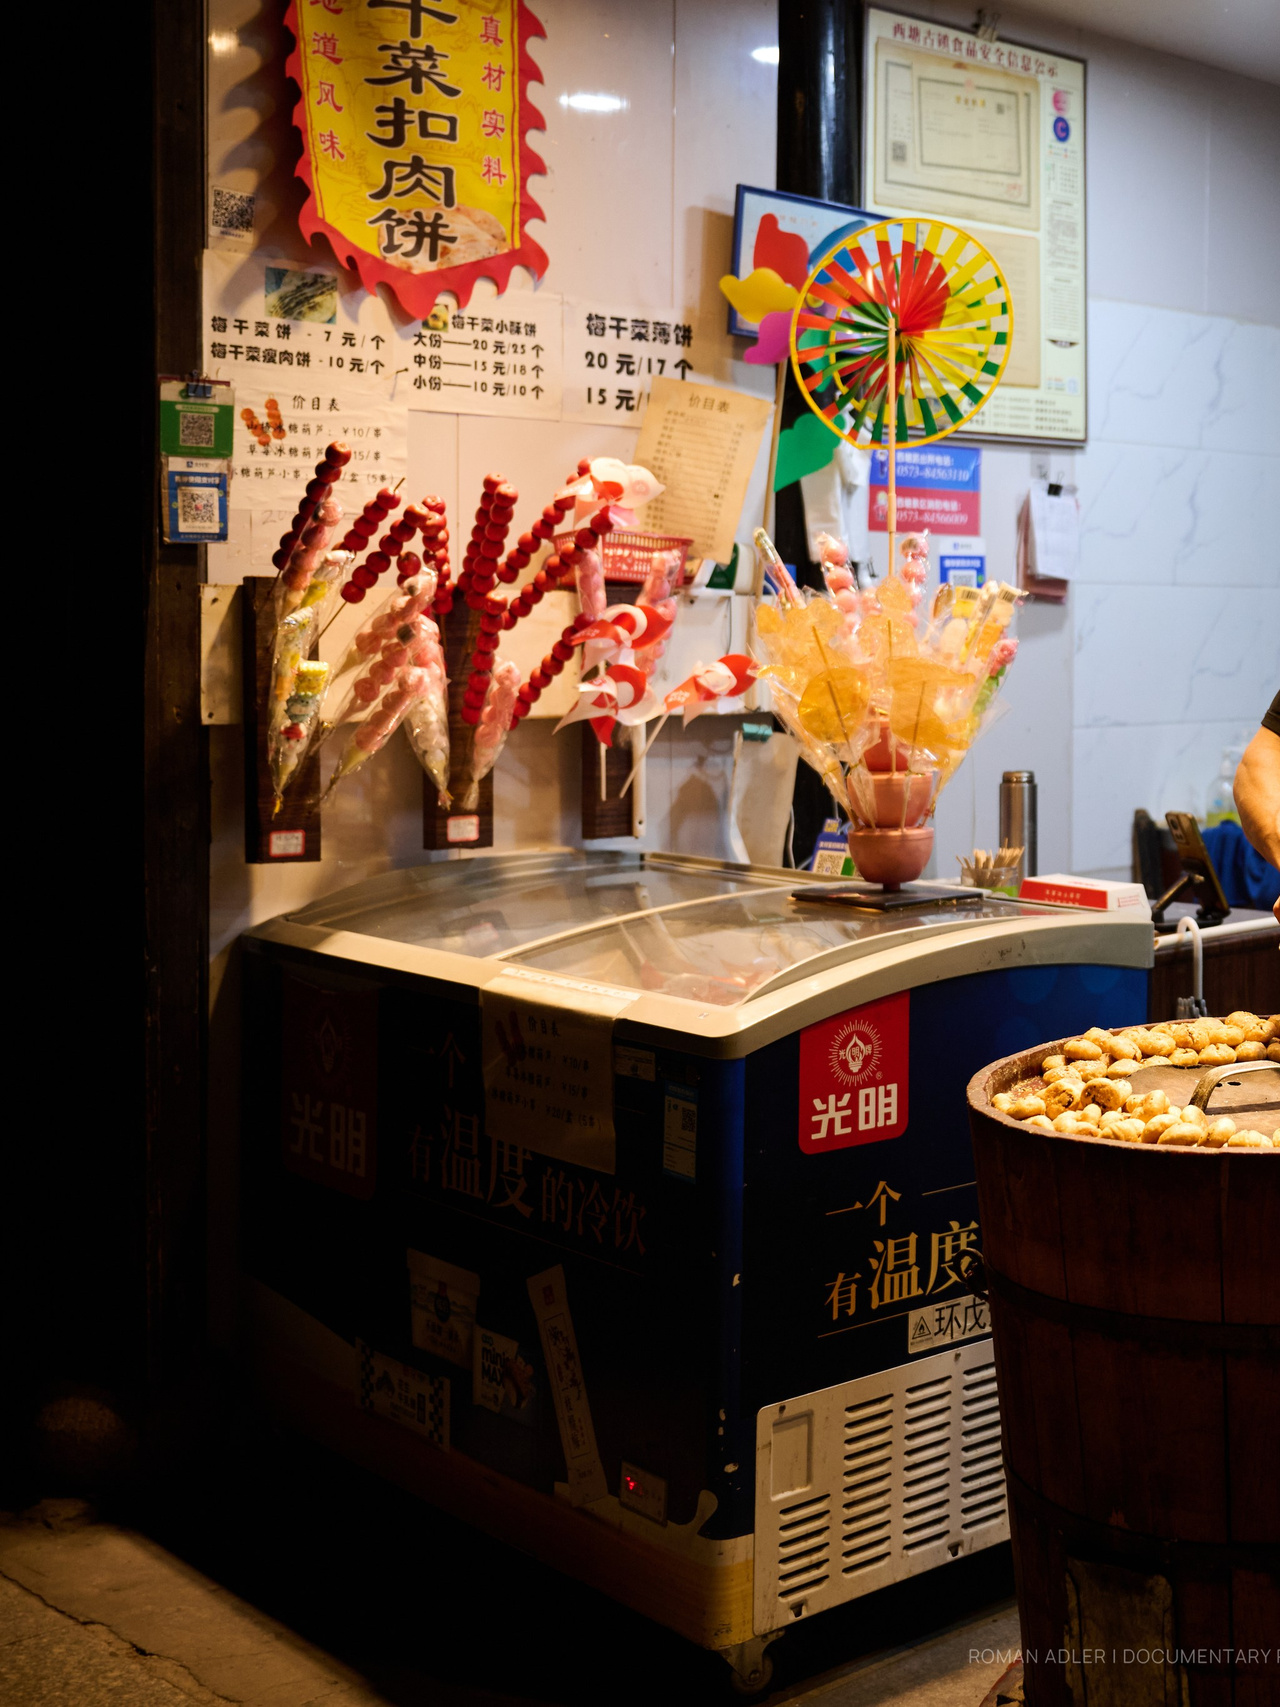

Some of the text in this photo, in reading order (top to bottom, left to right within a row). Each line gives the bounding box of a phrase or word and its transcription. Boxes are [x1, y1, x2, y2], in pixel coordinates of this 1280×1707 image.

[480, 15, 507, 186] 真材实料
[586, 313, 693, 348] 梅干菜薄饼
[292, 394, 340, 412] 价目表
[688, 392, 731, 414] 价目表
[290, 1091, 366, 1178] 光明
[811, 1083, 898, 1140] 光明
[405, 1103, 647, 1257] 有温度的冷饮
[825, 1180, 902, 1227] 一个
[824, 1220, 980, 1321] 有温度
[934, 1297, 992, 1340] 环戊
